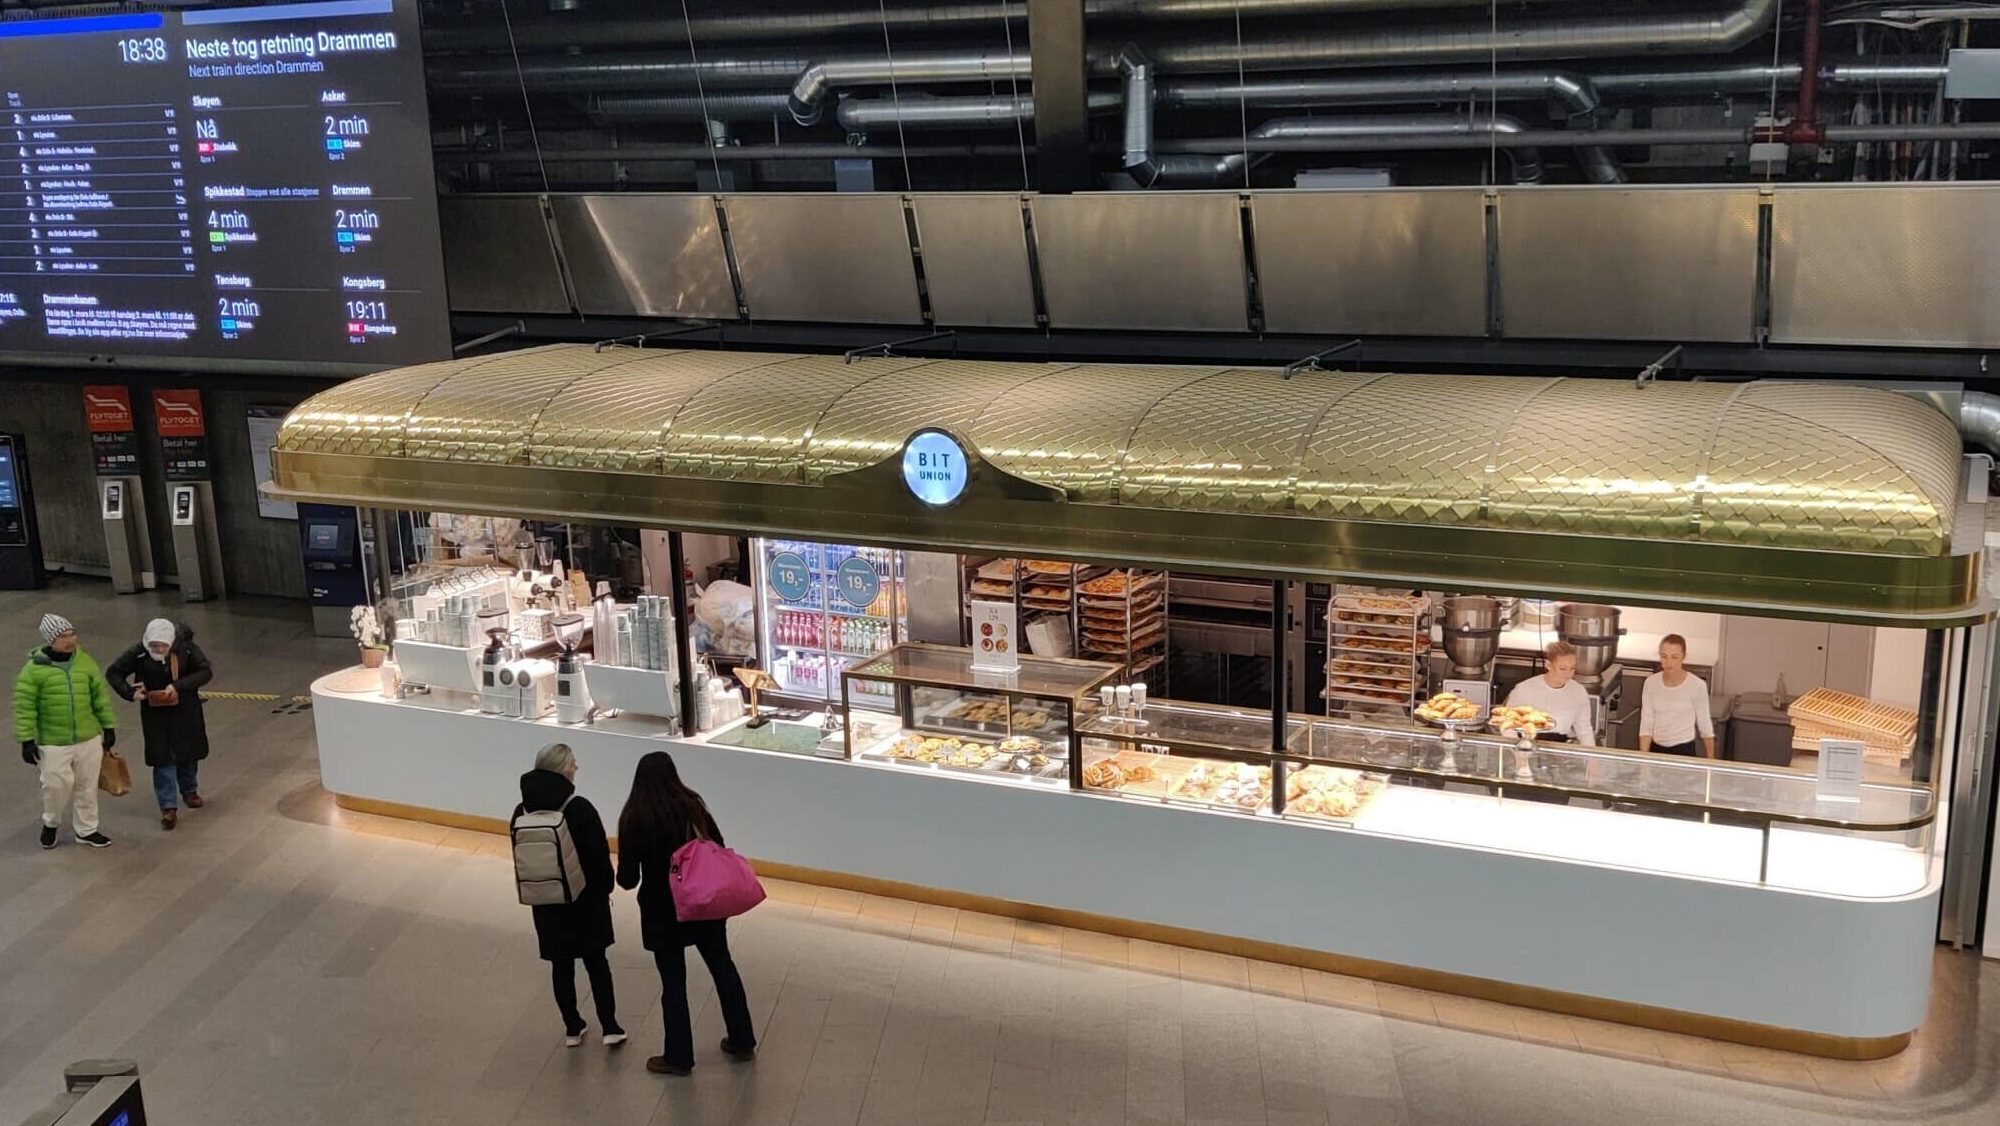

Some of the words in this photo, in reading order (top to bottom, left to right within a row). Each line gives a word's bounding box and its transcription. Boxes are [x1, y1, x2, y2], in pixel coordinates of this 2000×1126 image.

[118, 37, 167, 61] 18:38
[186, 39, 231, 59] Neste
[232, 38, 258, 60] tog
[261, 34, 314, 57] retning
[318, 31, 396, 52] Drammen
[189, 64, 211, 77] Next
[212, 63, 234, 76] train
[235, 61, 275, 75] direction
[276, 60, 324, 73] Drammen
[322, 89, 346, 101] Asker
[196, 118, 219, 139] Nå
[325, 115, 337, 135] 2
[339, 114, 369, 135] min
[204, 185, 245, 199] Spikkestad
[332, 184, 372, 196] Drammen
[208, 209, 219, 228] 4
[221, 209, 248, 228] min
[335, 209, 347, 228] 2
[349, 208, 379, 229] min
[342, 276, 386, 290] Kongsberg
[219, 298, 230, 316] 2
[231, 298, 260, 316] min
[346, 301, 387, 320] 19:11
[90, 412, 129, 420] FLYTOGET
[160, 416, 200, 425] FLYTOGET
[919, 452, 951, 468] BIT
[919, 471, 952, 481] UNION
